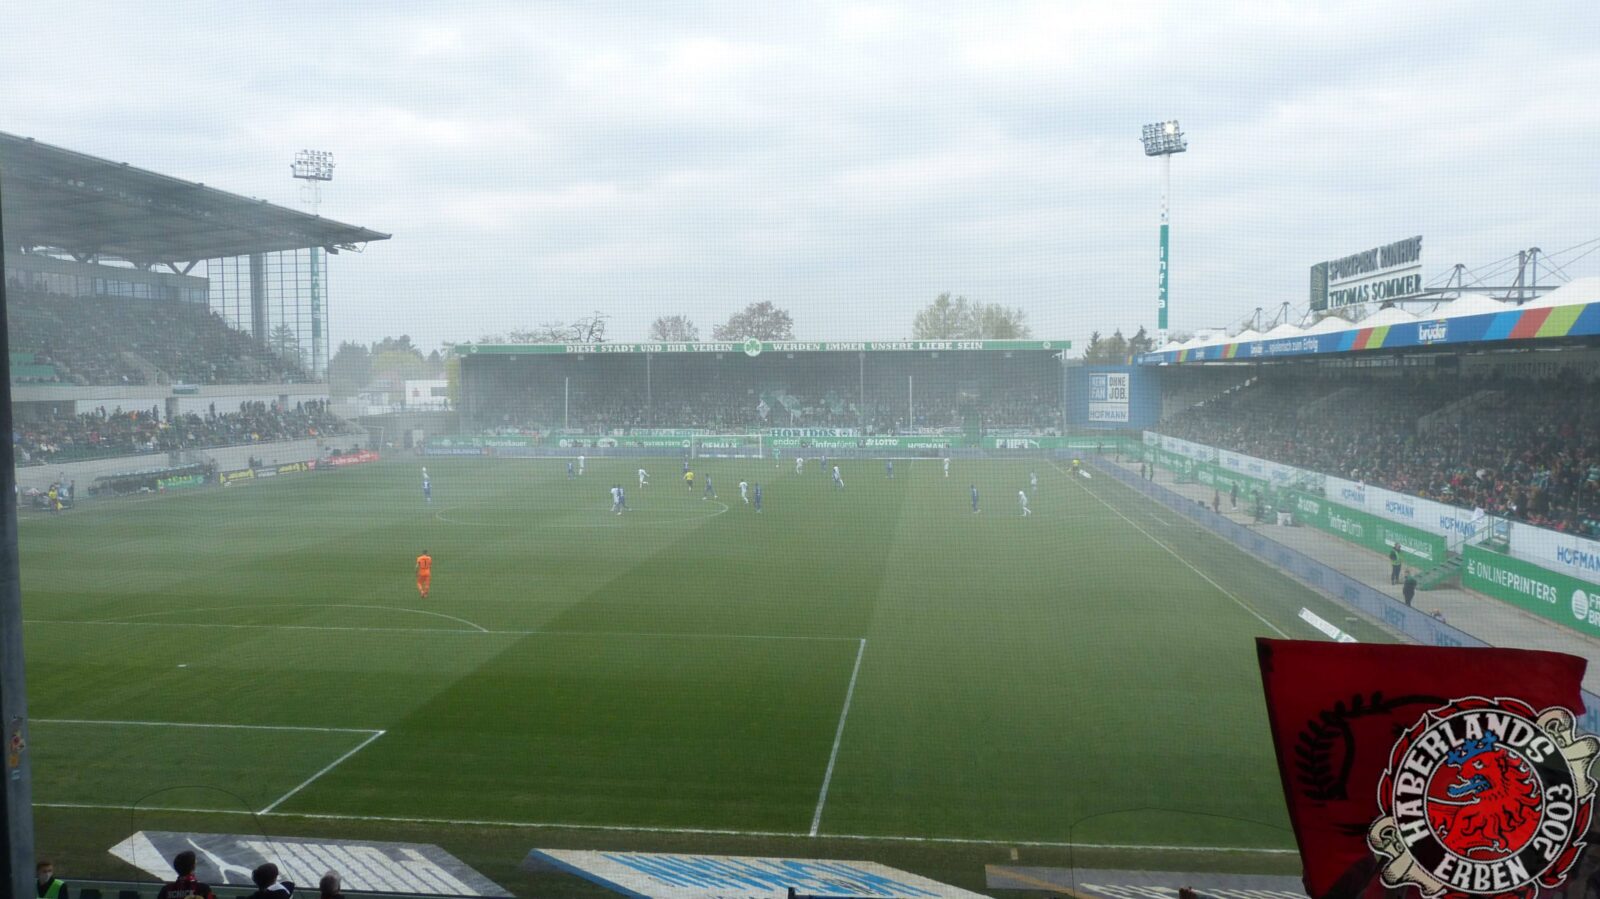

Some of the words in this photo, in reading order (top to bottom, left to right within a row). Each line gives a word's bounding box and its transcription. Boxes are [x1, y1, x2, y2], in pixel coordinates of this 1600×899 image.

[1328, 285, 1369, 309] THOMAS
[1371, 274, 1422, 301] SOMMER
[566, 345, 597, 353] DIESE
[600, 344, 636, 352] STADT
[640, 344, 662, 352] UND
[667, 343, 688, 352] IHR
[692, 343, 734, 352] VEREIN
[773, 343, 820, 351] WERDEN
[825, 342, 866, 351] IMMER
[871, 342, 914, 350] UNSERE
[919, 342, 952, 350] LIEBE
[957, 342, 984, 350] SEIN
[1109, 376, 1126, 387] OHNE
[1109, 387, 1127, 400] JOB.
[875, 438, 898, 446] LOTTO
[1385, 499, 1414, 518] HOFMANN
[1440, 515, 1476, 536] HOFMANN
[1476, 562, 1557, 604] ONLINEPRINTERS
[1397, 713, 1555, 847] HABERLANDS
[1533, 783, 1574, 862] 2003
[1433, 852, 1530, 891] ERBEN
